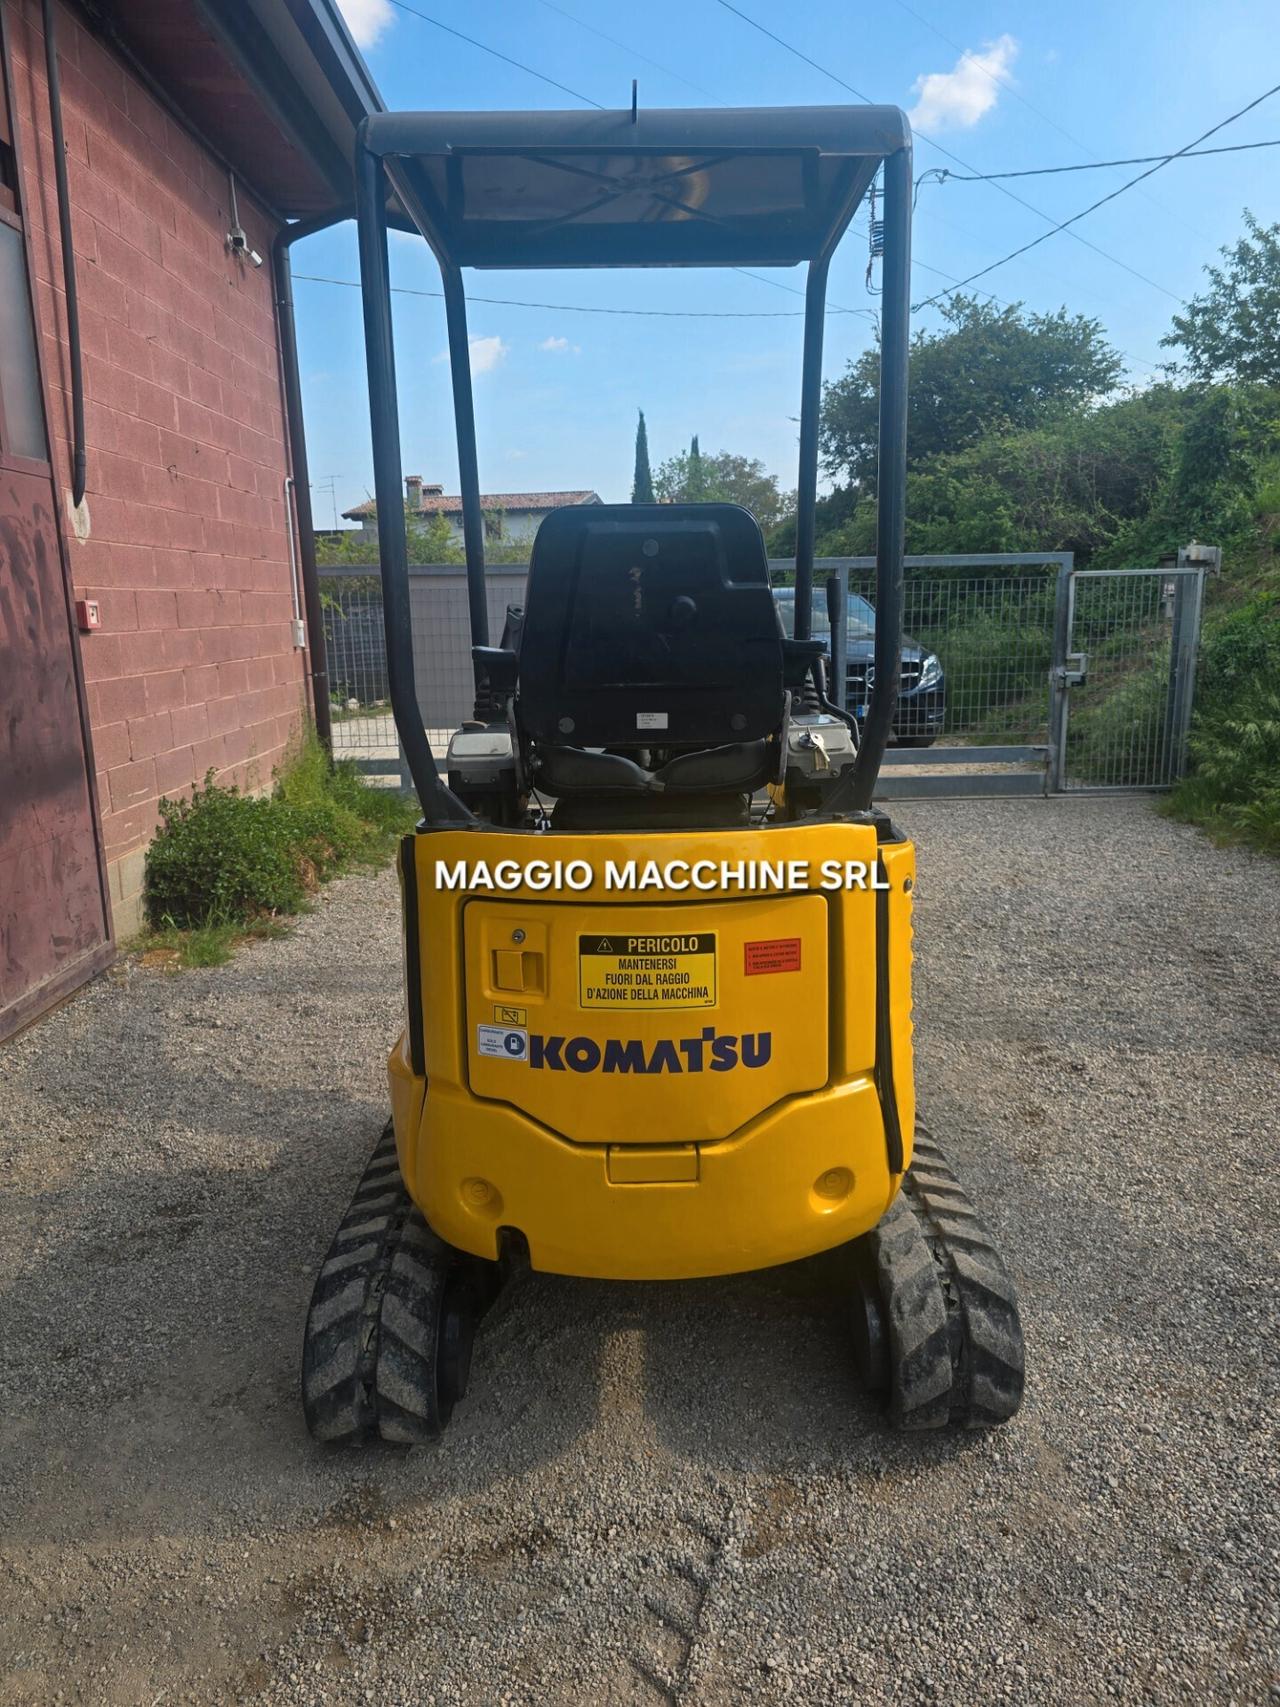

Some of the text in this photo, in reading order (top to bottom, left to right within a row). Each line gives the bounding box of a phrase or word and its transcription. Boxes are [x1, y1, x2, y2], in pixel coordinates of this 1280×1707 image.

[627, 936, 699, 953] PERICOLO
[618, 958, 677, 970] MANTENERSI
[605, 972, 690, 985] FUORI DAL RAGGIO
[586, 986, 709, 1001] D'AZIONE DELLA MACCHINA
[529, 1026, 772, 1074] KOMATSU
